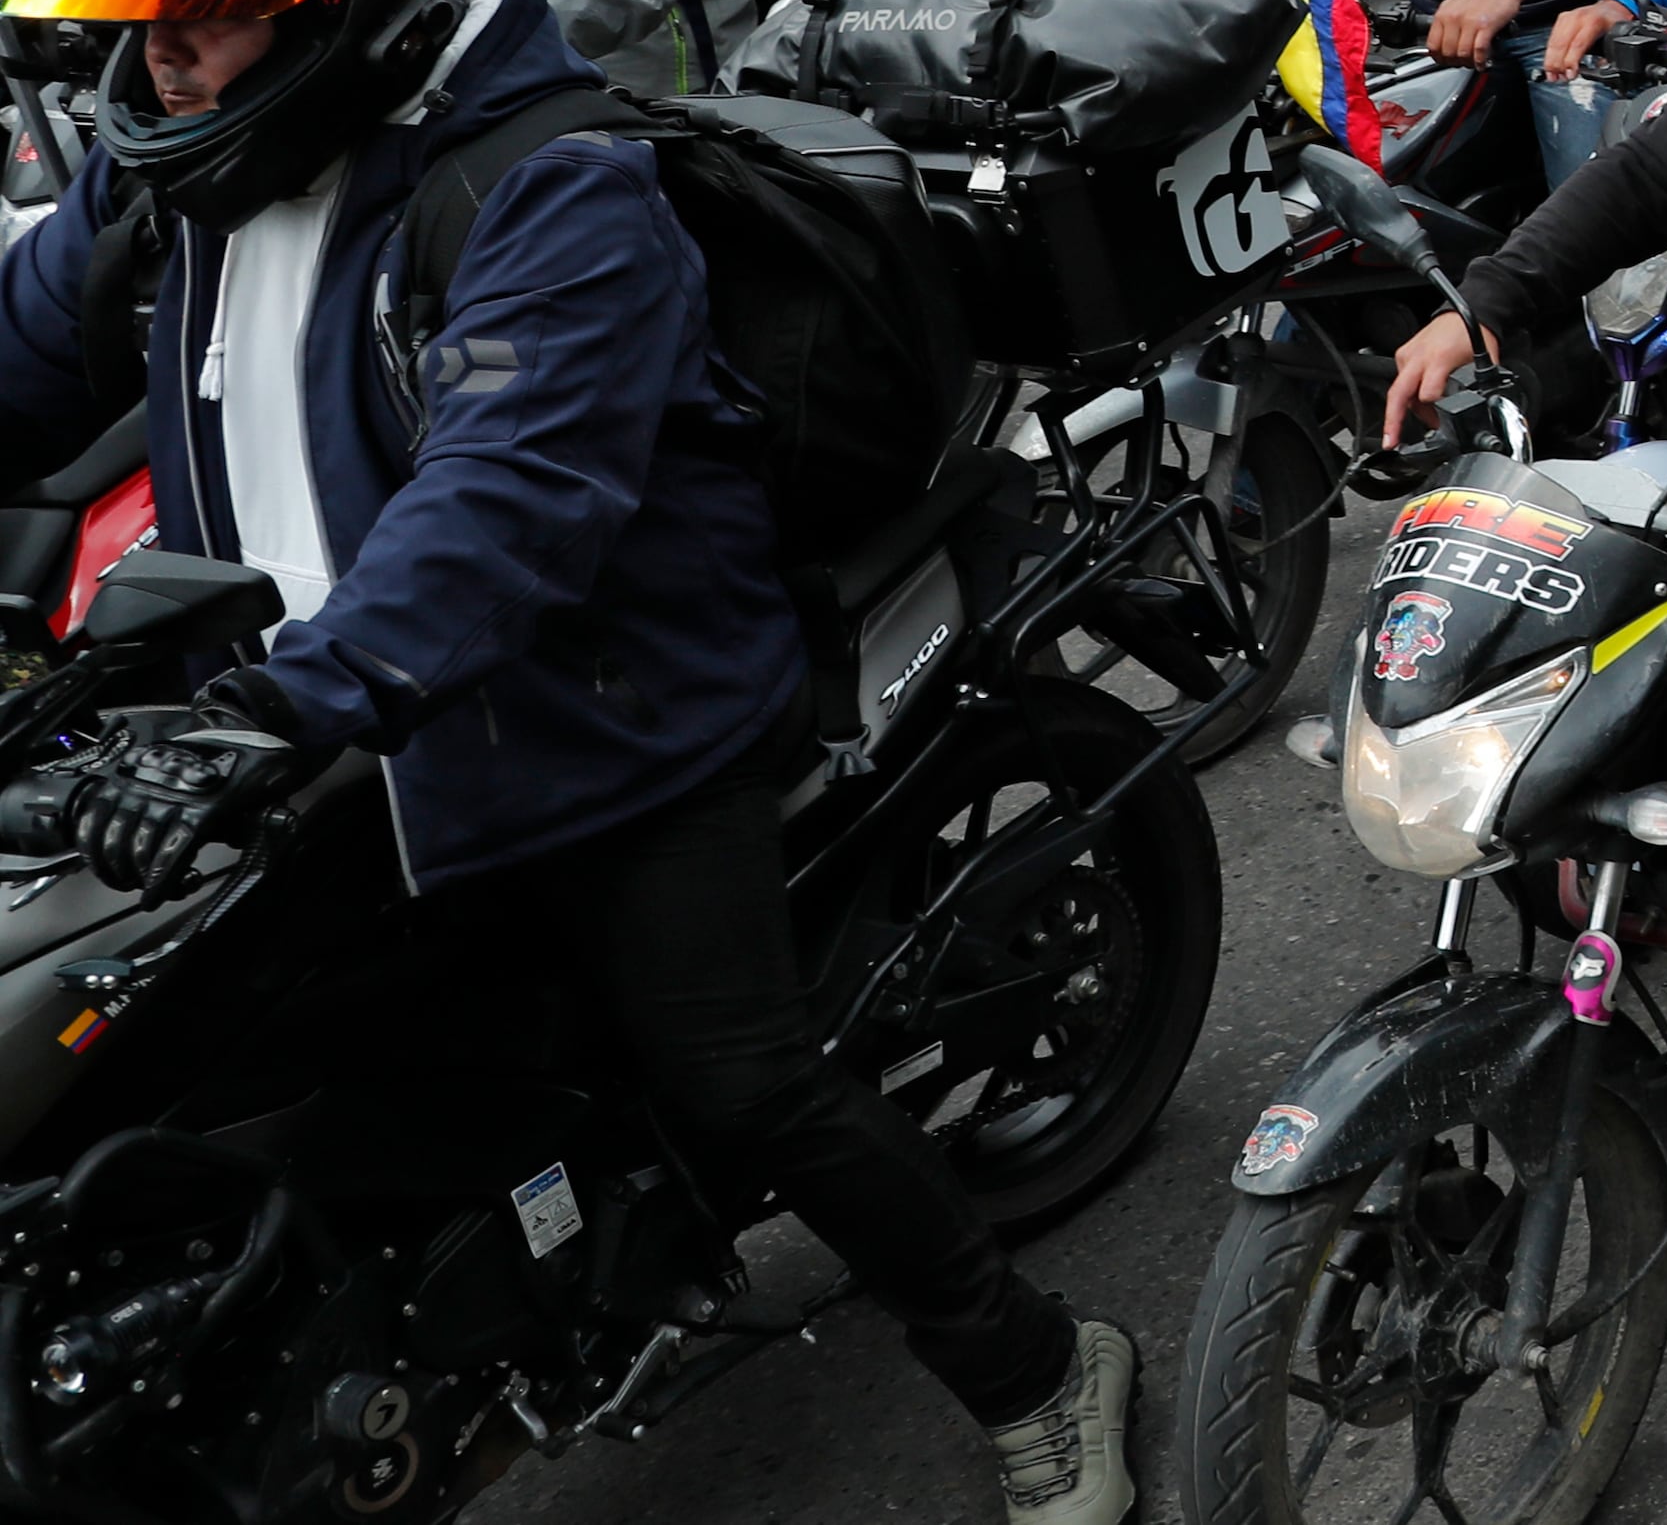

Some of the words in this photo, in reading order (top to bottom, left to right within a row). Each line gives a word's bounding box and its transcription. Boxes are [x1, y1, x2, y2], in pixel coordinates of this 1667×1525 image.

[838, 8, 956, 33] PARAMO
[1391, 487, 1595, 561] FIRE
[1373, 538, 1586, 615] RIDERS
